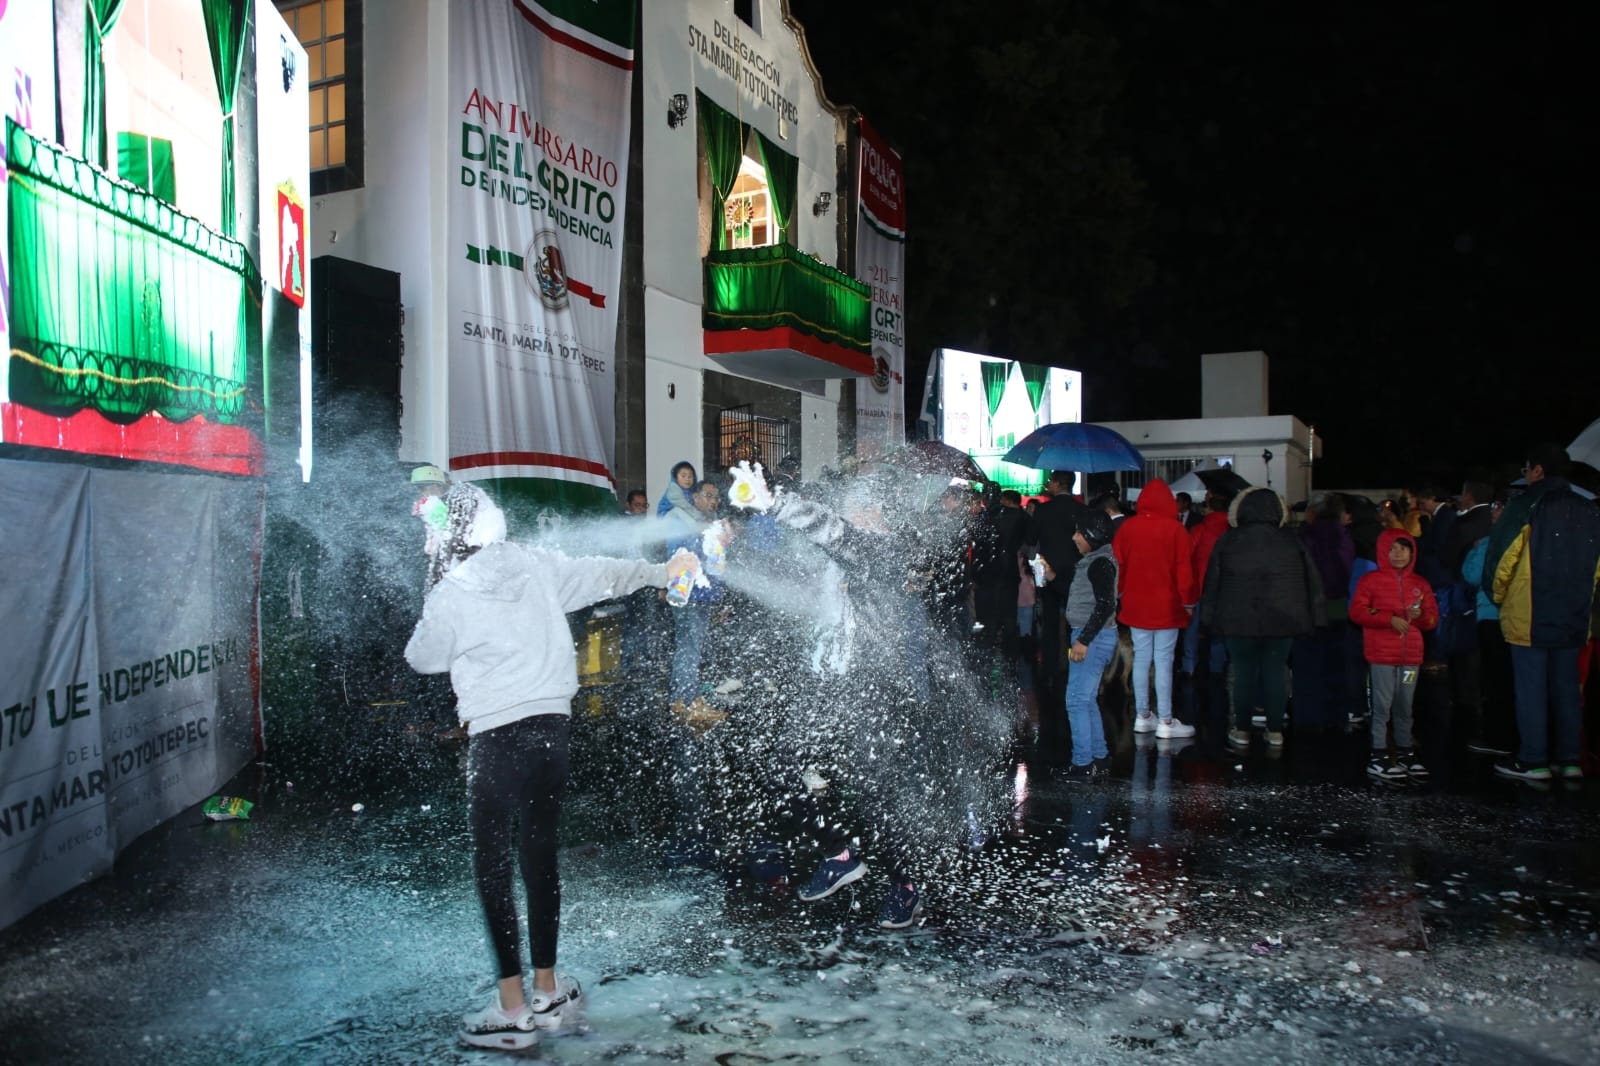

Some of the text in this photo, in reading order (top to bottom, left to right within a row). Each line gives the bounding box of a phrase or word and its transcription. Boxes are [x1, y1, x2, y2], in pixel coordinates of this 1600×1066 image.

[713, 19, 780, 86] DELEGACIÓN
[461, 121, 533, 182] DEL
[461, 165, 490, 193] DE
[463, 321, 507, 345] SANTA
[512, 333, 554, 356] MARÍA
[111, 717, 209, 778] TOTOLTEPEC
